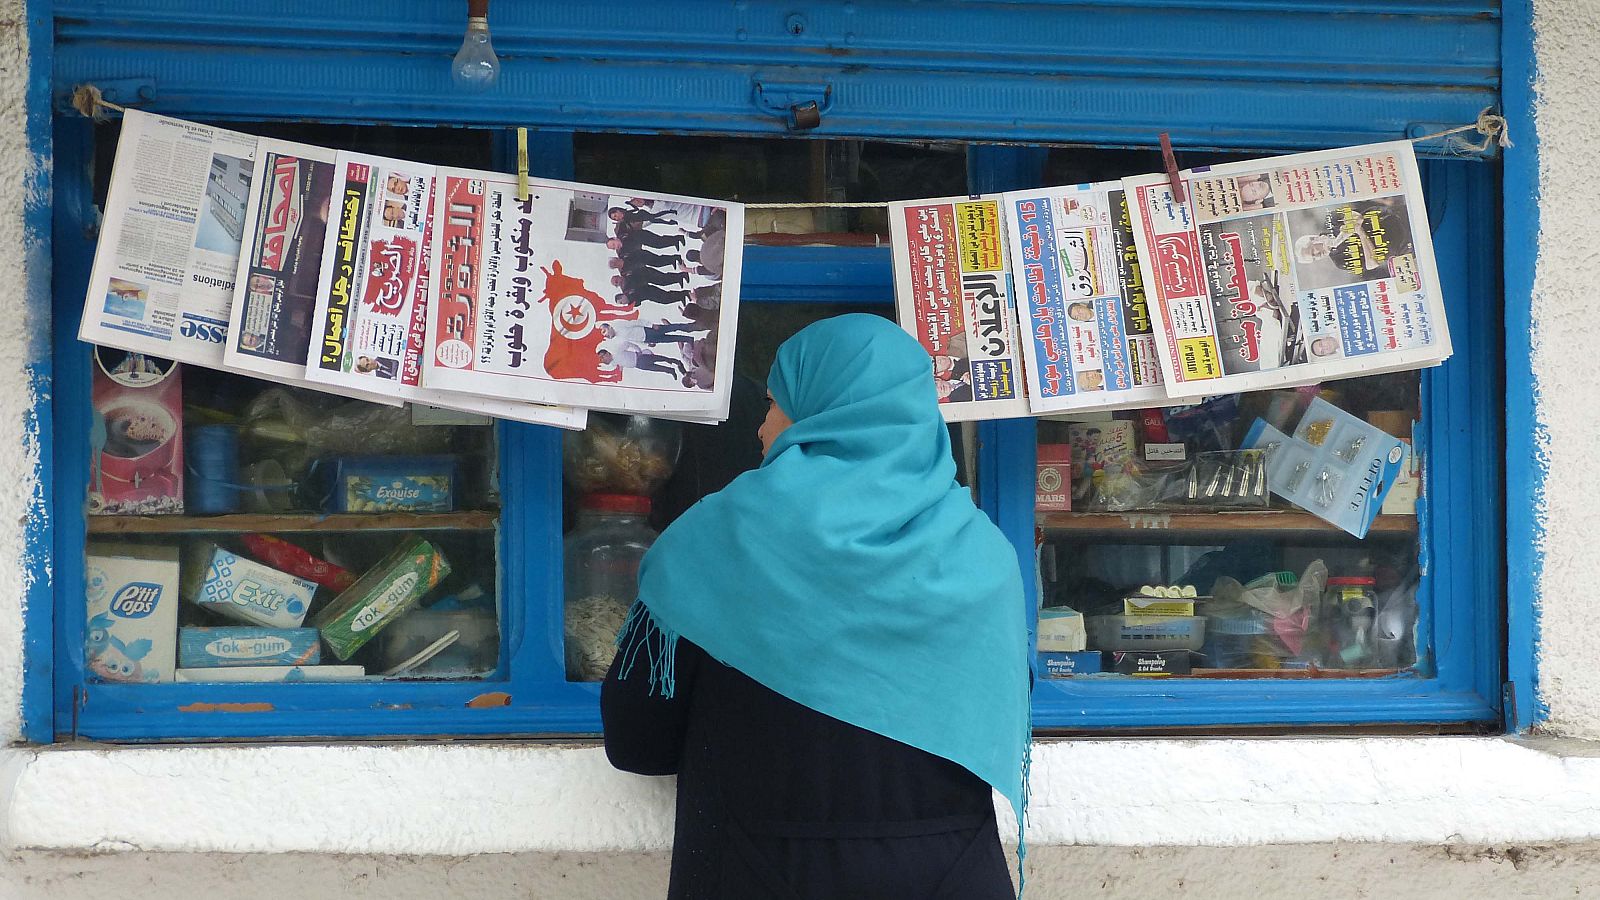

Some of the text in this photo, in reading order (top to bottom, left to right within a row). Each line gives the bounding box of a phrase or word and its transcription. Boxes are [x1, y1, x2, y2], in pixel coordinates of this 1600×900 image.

[256, 154, 299, 271] الصحافة
[335, 188, 361, 261] اختطاف
[1019, 201, 1036, 222] 15
[507, 217, 538, 272] منكوب
[1021, 223, 1046, 260] دقيقة
[1063, 228, 1094, 298] الشروق
[1154, 233, 1194, 294] التونسية
[1202, 228, 1218, 260] التشريح
[330, 264, 353, 305] رجل
[1217, 229, 1257, 318] استنطاق
[504, 275, 533, 319] وبقرة
[962, 272, 1010, 358] الإعلان
[964, 291, 980, 338] الجديد
[500, 322, 530, 368] حلوب
[1040, 363, 1062, 395] سوسة
[1036, 494, 1066, 503] MARS
[1350, 458, 1382, 512] OFFICE
[231, 579, 285, 612] Exit
